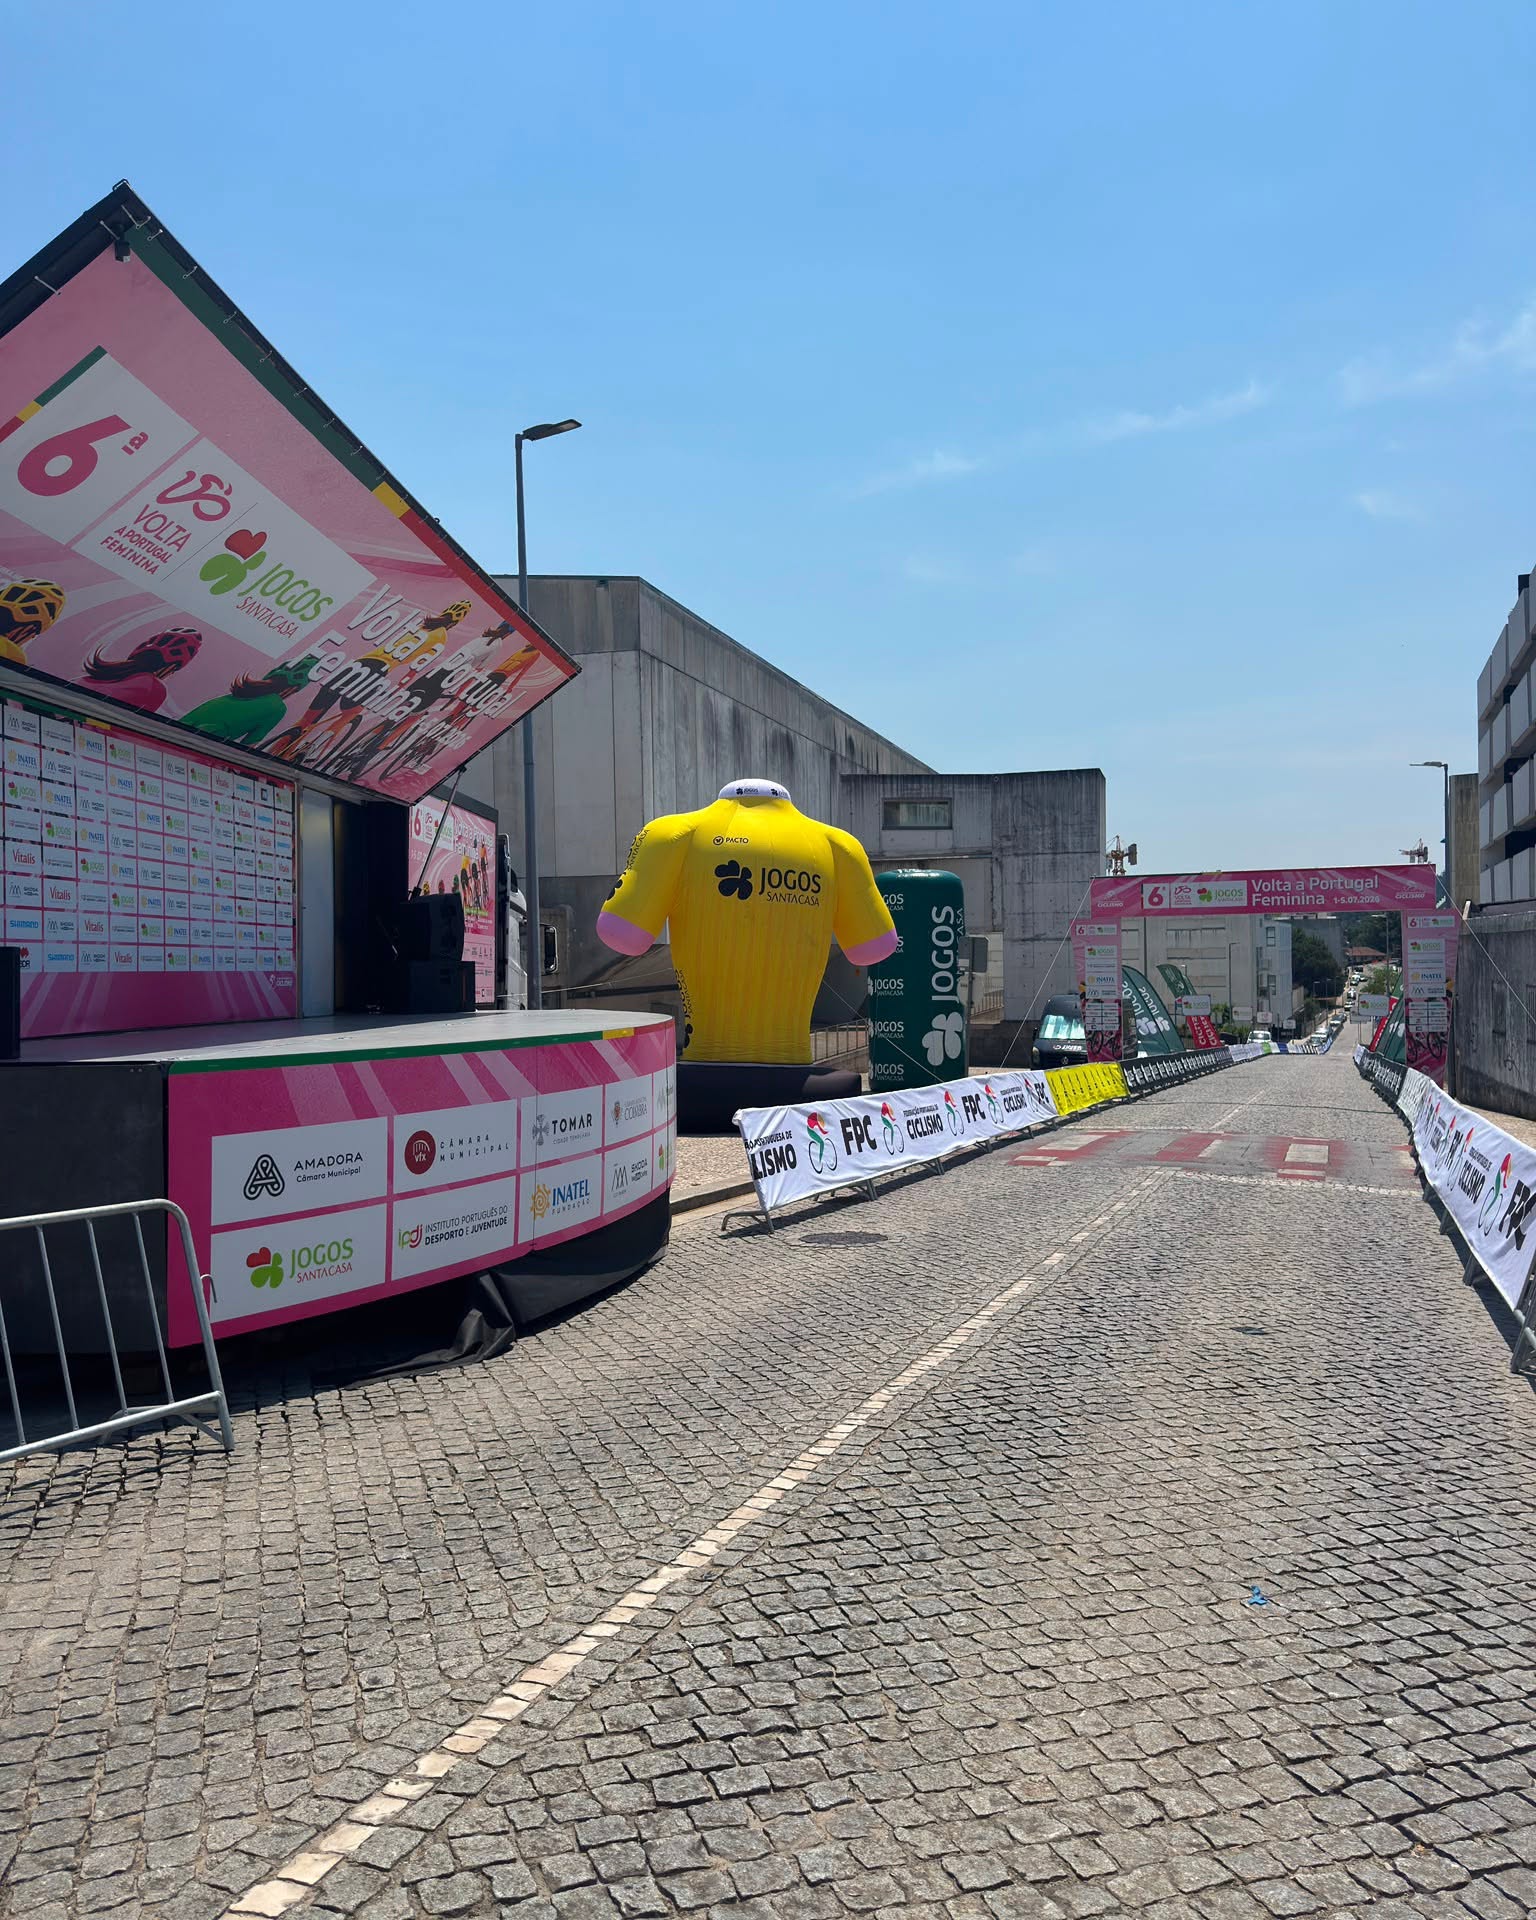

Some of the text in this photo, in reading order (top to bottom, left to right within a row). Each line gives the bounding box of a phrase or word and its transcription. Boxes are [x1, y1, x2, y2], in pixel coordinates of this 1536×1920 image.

[17, 414, 149, 497] 6ª
[133, 504, 192, 552] VOLTA
[100, 536, 160, 575] FEMININA
[123, 527, 174, 564] PORTUGAL
[237, 562, 333, 622] JOGOS
[347, 583, 429, 662] Volta
[426, 652, 527, 721] Portugal
[287, 630, 422, 723] Feminina
[18, 754, 36, 765] INATEL
[13, 848, 35, 864] Vitalis
[759, 868, 821, 895] JOGOS
[1251, 875, 1379, 893] Volta a Portugal
[50, 886, 71, 901] Vitalis
[767, 892, 820, 907] SANTACASA
[883, 894, 904, 905] GOS
[1215, 888, 1244, 900] JOGOS
[1252, 893, 1325, 907] Feminina
[1395, 892, 1426, 900] CICLISMO
[10, 920, 38, 928] SHIMANO
[931, 905, 959, 1004] JOGOS
[875, 978, 904, 993] JOGOS
[875, 1021, 904, 1036] JOGOS
[875, 1063, 904, 1078] JOGOS
[962, 1094, 986, 1124] FPC
[552, 1113, 593, 1135] TOMAR
[906, 1113, 944, 1140] CICLISMO
[440, 1134, 489, 1149] CÂMARA
[840, 1115, 877, 1156] FPC
[294, 1152, 363, 1171] AMADORA
[415, 1152, 427, 1163] vfx
[440, 1143, 509, 1161] MUNICIPAL
[750, 1143, 797, 1180] LISMO
[296, 1167, 361, 1183] Câmara Municipal
[552, 1179, 591, 1206] INATEL
[425, 1205, 508, 1233] INSTITUTO PORTUGUÊS DO
[398, 1224, 423, 1248] ipdj
[425, 1216, 508, 1246] DESPORTO E JUVENTUDE
[289, 1238, 353, 1279] JOGOS
